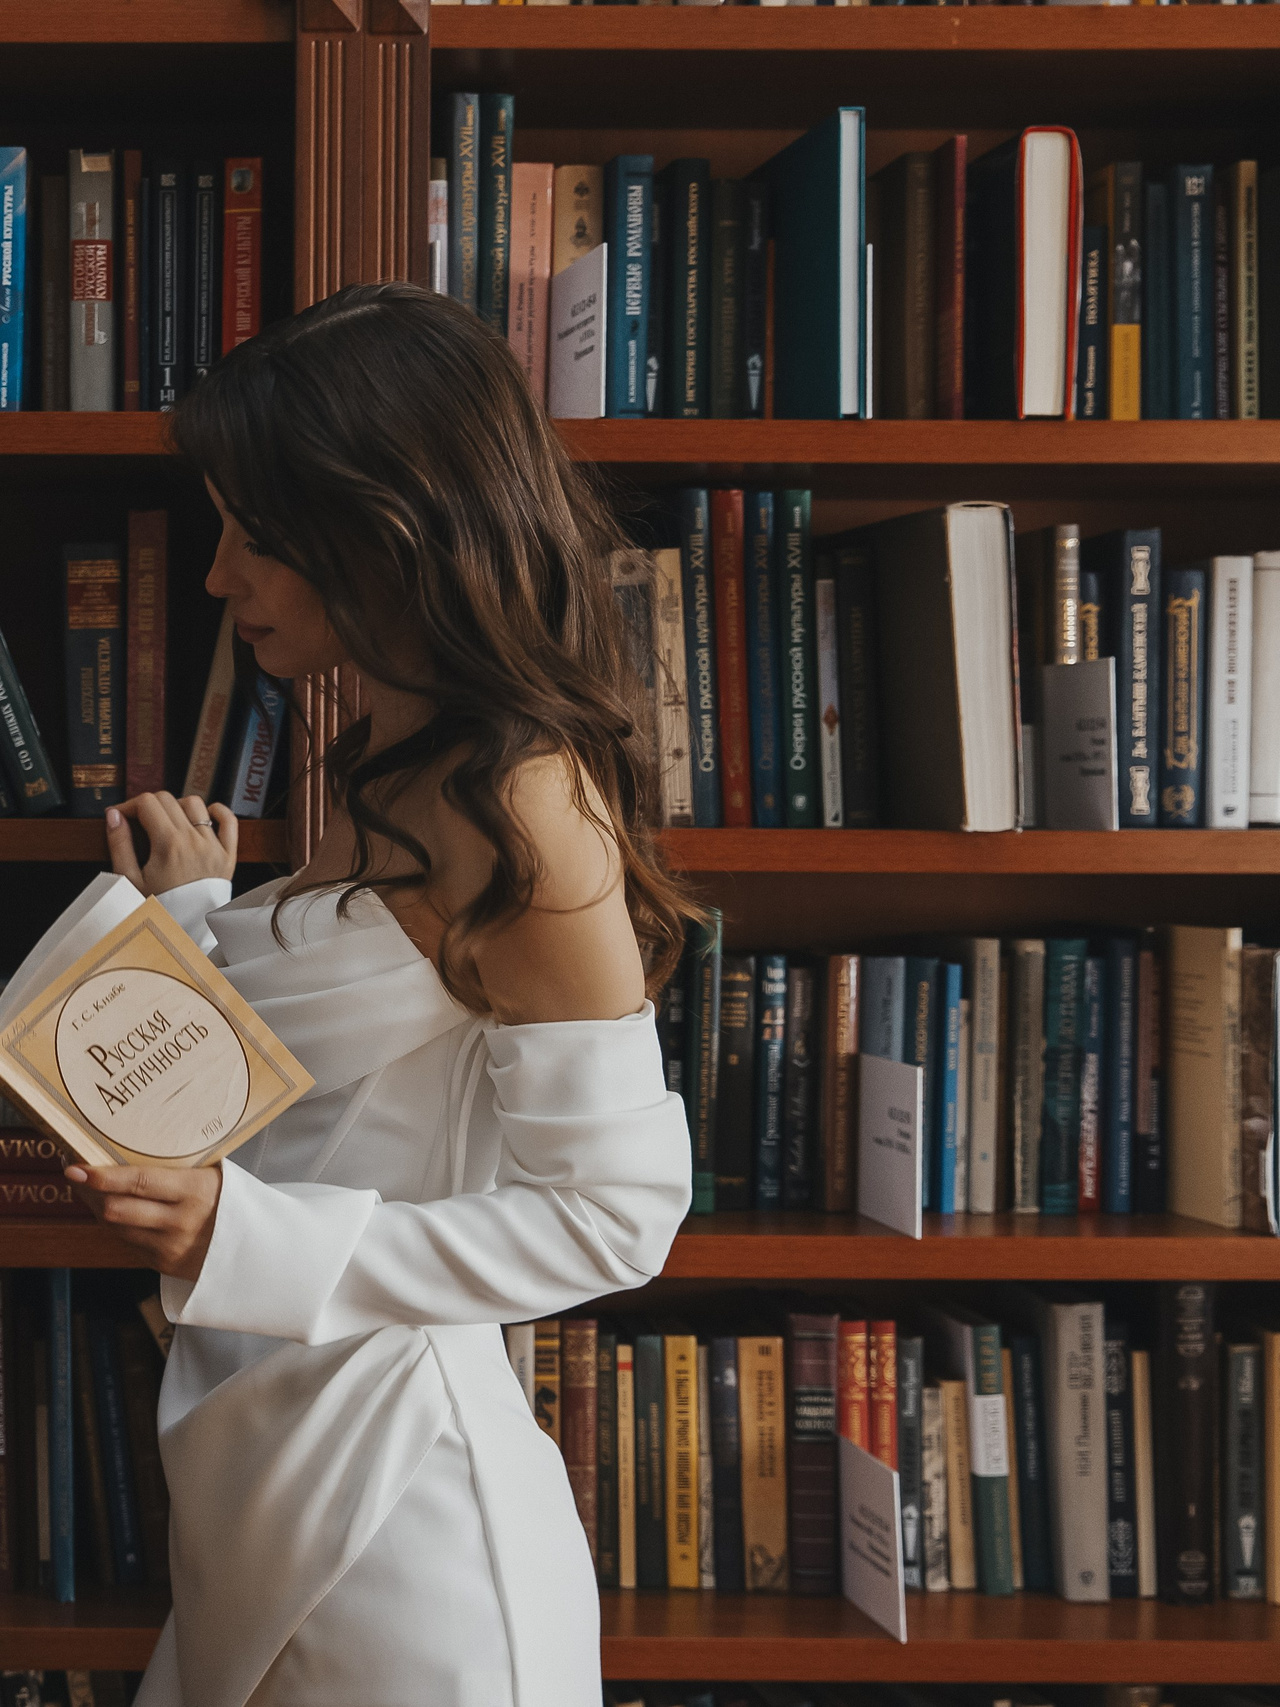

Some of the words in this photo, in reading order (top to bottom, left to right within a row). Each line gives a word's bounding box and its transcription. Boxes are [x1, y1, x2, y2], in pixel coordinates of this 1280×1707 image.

[459, 126, 475, 157] XVII
[491, 135, 506, 167] XVII
[3, 186, 14, 240] КУЛЬТУРЫ
[461, 161, 477, 231] культуры
[492, 174, 508, 242] культуры
[626, 184, 644, 256] РОМАНОВЫ
[687, 181, 699, 265] РОССИЙСКОГО
[2, 242, 12, 286] РУССКОЙ
[236, 216, 252, 264] КУЛЬТУРЫ
[85, 244, 96, 300] РУССКОЙ
[96, 244, 108, 300] КУЛЬТУРЫ
[234, 267, 252, 308] РУССКОЙ
[626, 263, 642, 315] ПЕРВЫЕ
[1085, 249, 1099, 324] ПОЛИТИКА
[236, 311, 251, 331] МИР
[686, 269, 697, 346] ГОСУДАРСТВА
[686, 350, 696, 402] ИСТОРИЯ
[689, 533, 705, 569] XVIII
[787, 533, 802, 568] XVIII
[695, 575, 709, 643] культуры
[789, 574, 806, 643] культуры
[97, 636, 112, 695] ОТЕЧЕСТВА
[696, 648, 713, 709] русской
[788, 647, 807, 708] русской
[1, 702, 26, 748] ВЕЛИКИХ
[98, 698, 112, 745] ИСТОРИИ
[699, 714, 714, 772] Очерки
[789, 713, 806, 770] Очерки
[18, 748, 35, 771] СТО
[72, 1019, 84, 1031] Г.
[81, 1010, 95, 1023] С.
[92, 982, 126, 1013] Кнабе
[85, 1009, 171, 1079] РУССКАЯ
[94, 1021, 209, 1116] АНТИЧНОСТЬ
